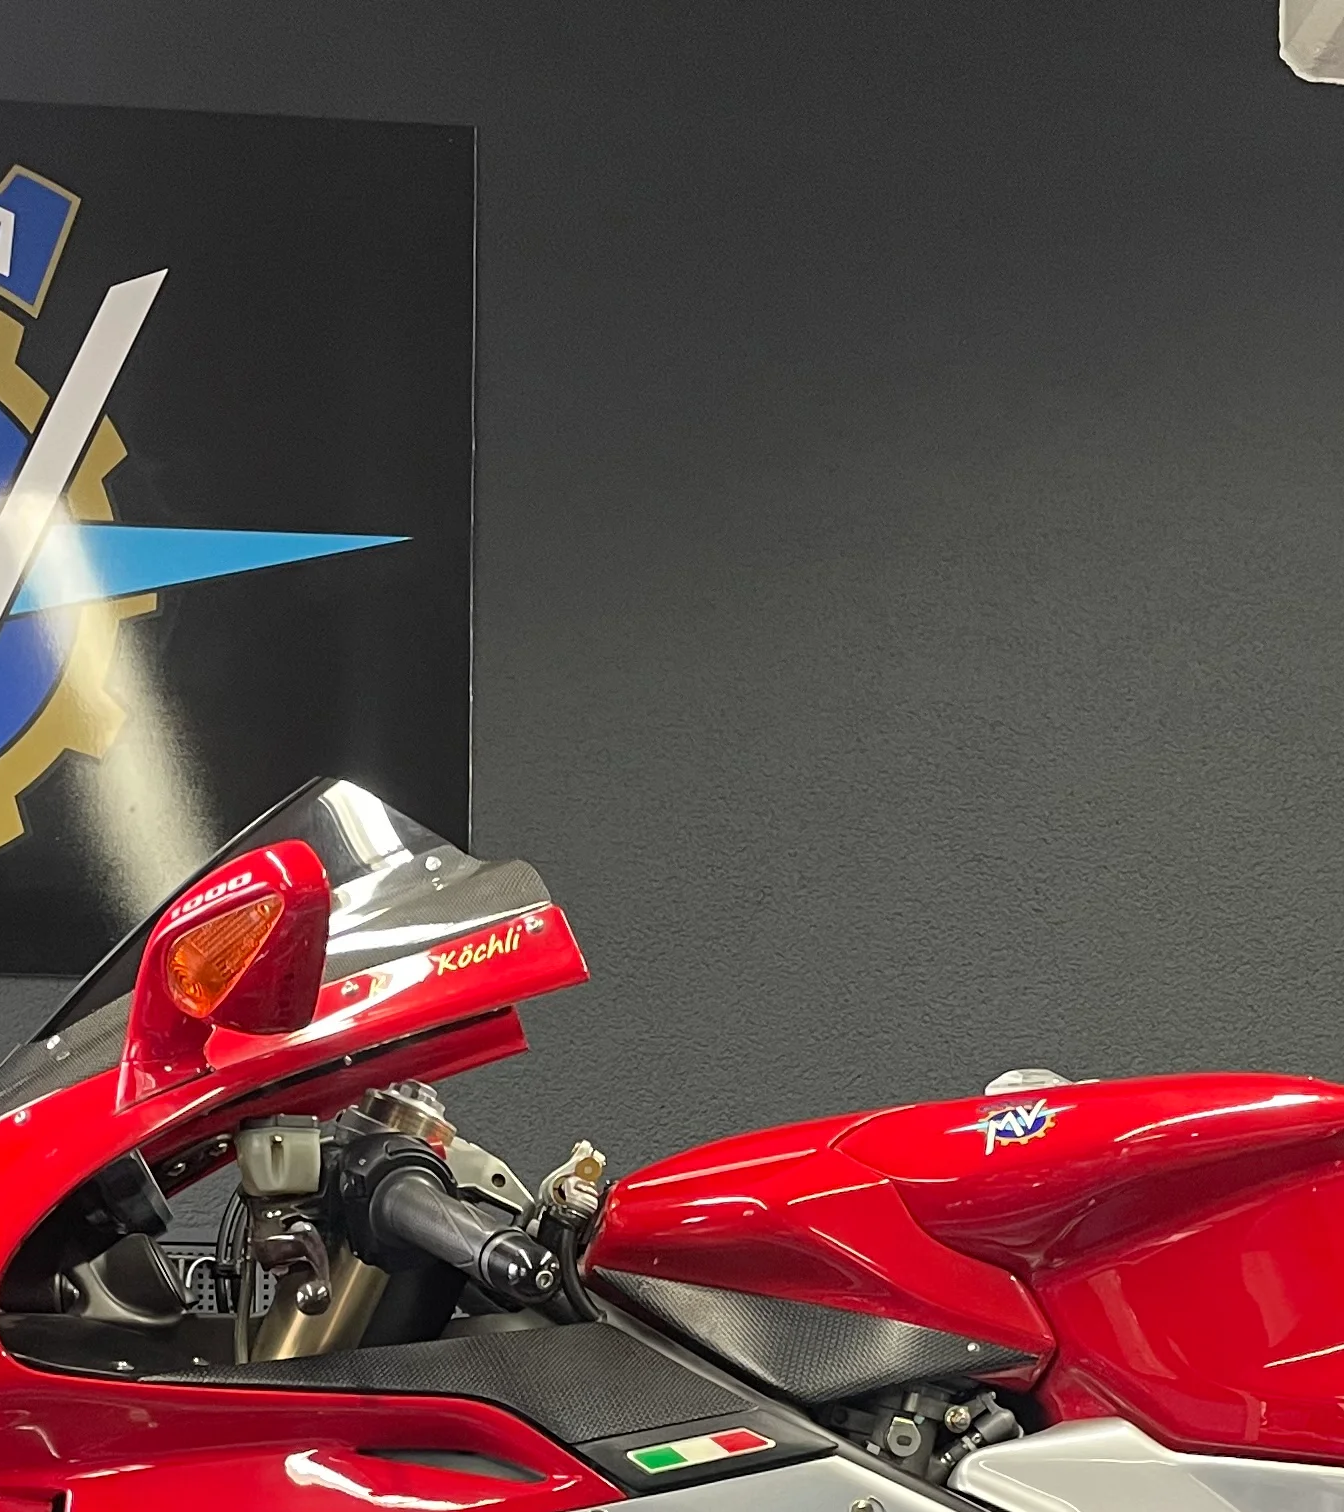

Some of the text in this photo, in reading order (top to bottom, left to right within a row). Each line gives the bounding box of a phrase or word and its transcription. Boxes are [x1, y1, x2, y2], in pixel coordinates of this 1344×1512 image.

[170, 871, 253, 920] 1000
[437, 924, 523, 976] Köchli
[985, 1098, 1047, 1155] MV
